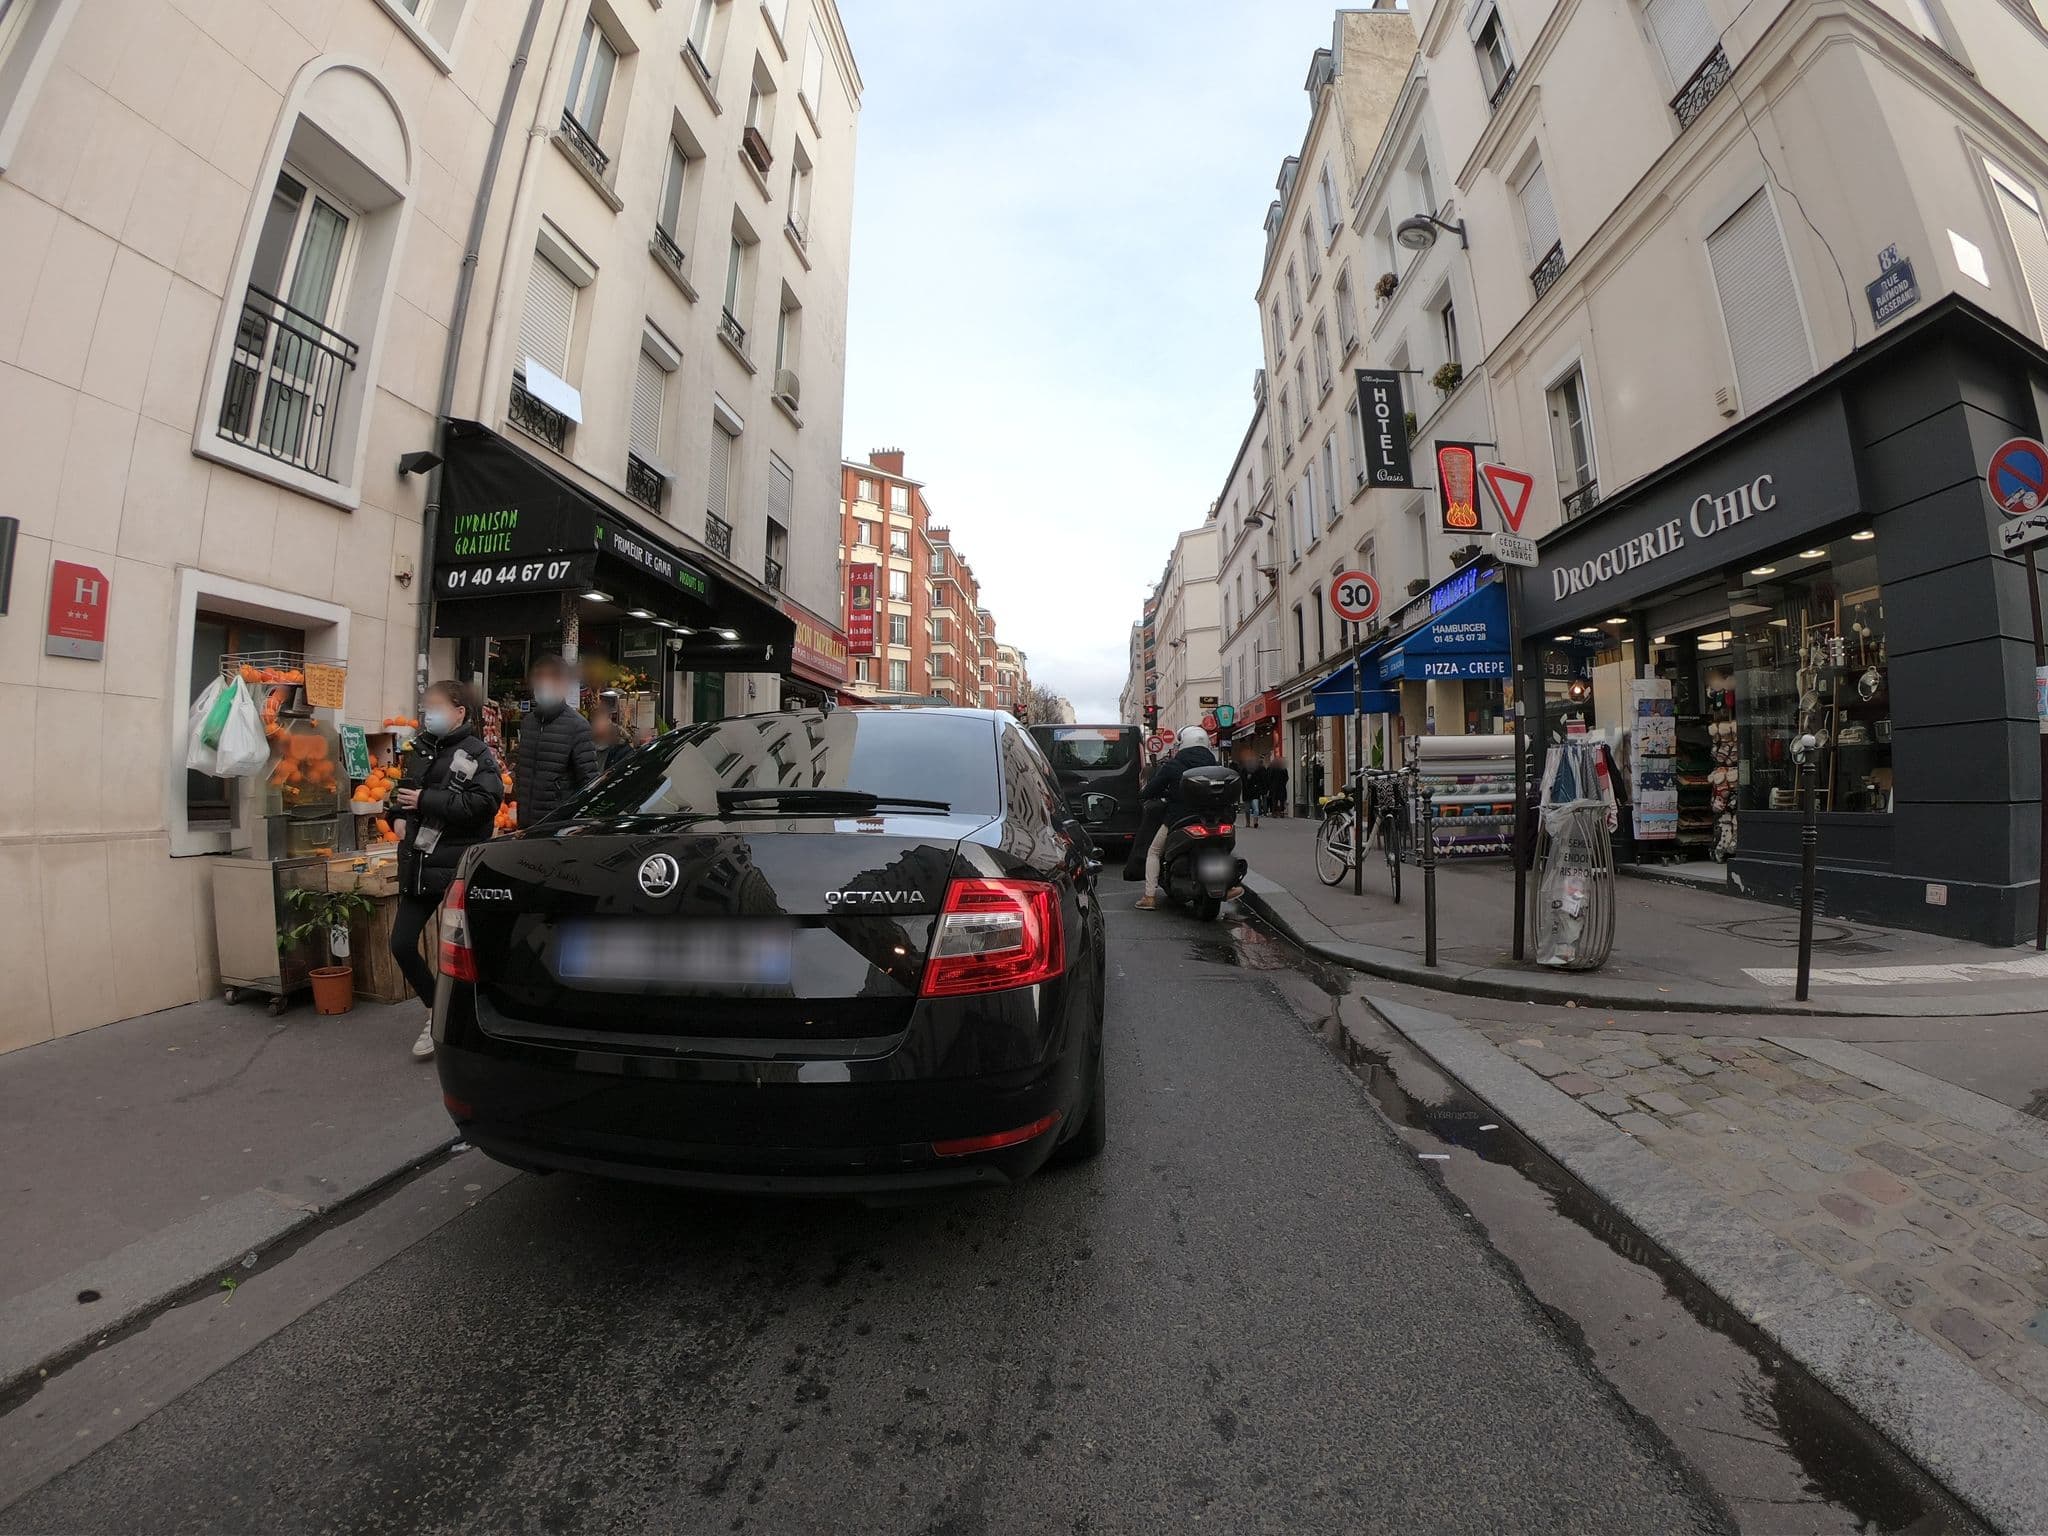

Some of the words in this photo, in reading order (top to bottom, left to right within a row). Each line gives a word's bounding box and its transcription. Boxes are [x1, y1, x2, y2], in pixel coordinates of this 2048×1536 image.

[1881, 273, 1900, 290] RUE
[1875, 280, 1909, 308] RAYMOND
[1373, 387, 1395, 466] HOTEL
[1376, 468, 1404, 482] Oasis
[454, 509, 519, 534] LIVRAISON
[455, 532, 512, 555] GRATUITE
[1524, 543, 1533, 552] LE
[1552, 518, 1685, 601] DROGUERIE
[1690, 474, 1776, 538] CHIC
[613, 533, 643, 562] PRIMEUR
[644, 550, 653, 568] DE
[1501, 548, 1533, 562] PASSAGE
[447, 570, 467, 588] 01
[471, 567, 492, 585] 40
[495, 565, 517, 583] 44
[521, 563, 544, 581] 67
[547, 561, 571, 580] 07
[74, 577, 101, 607] H
[1340, 584, 1371, 607] 30
[1431, 623, 1487, 634] HAMBURGER
[1434, 635, 1443, 643] 01
[1444, 635, 1454, 643] 45
[1455, 634, 1465, 642] 45
[1477, 633, 1486, 641] 28
[1425, 663, 1459, 675] PIZZA
[1469, 661, 1505, 674] CREPE
[825, 890, 926, 905] OCTAVIA
